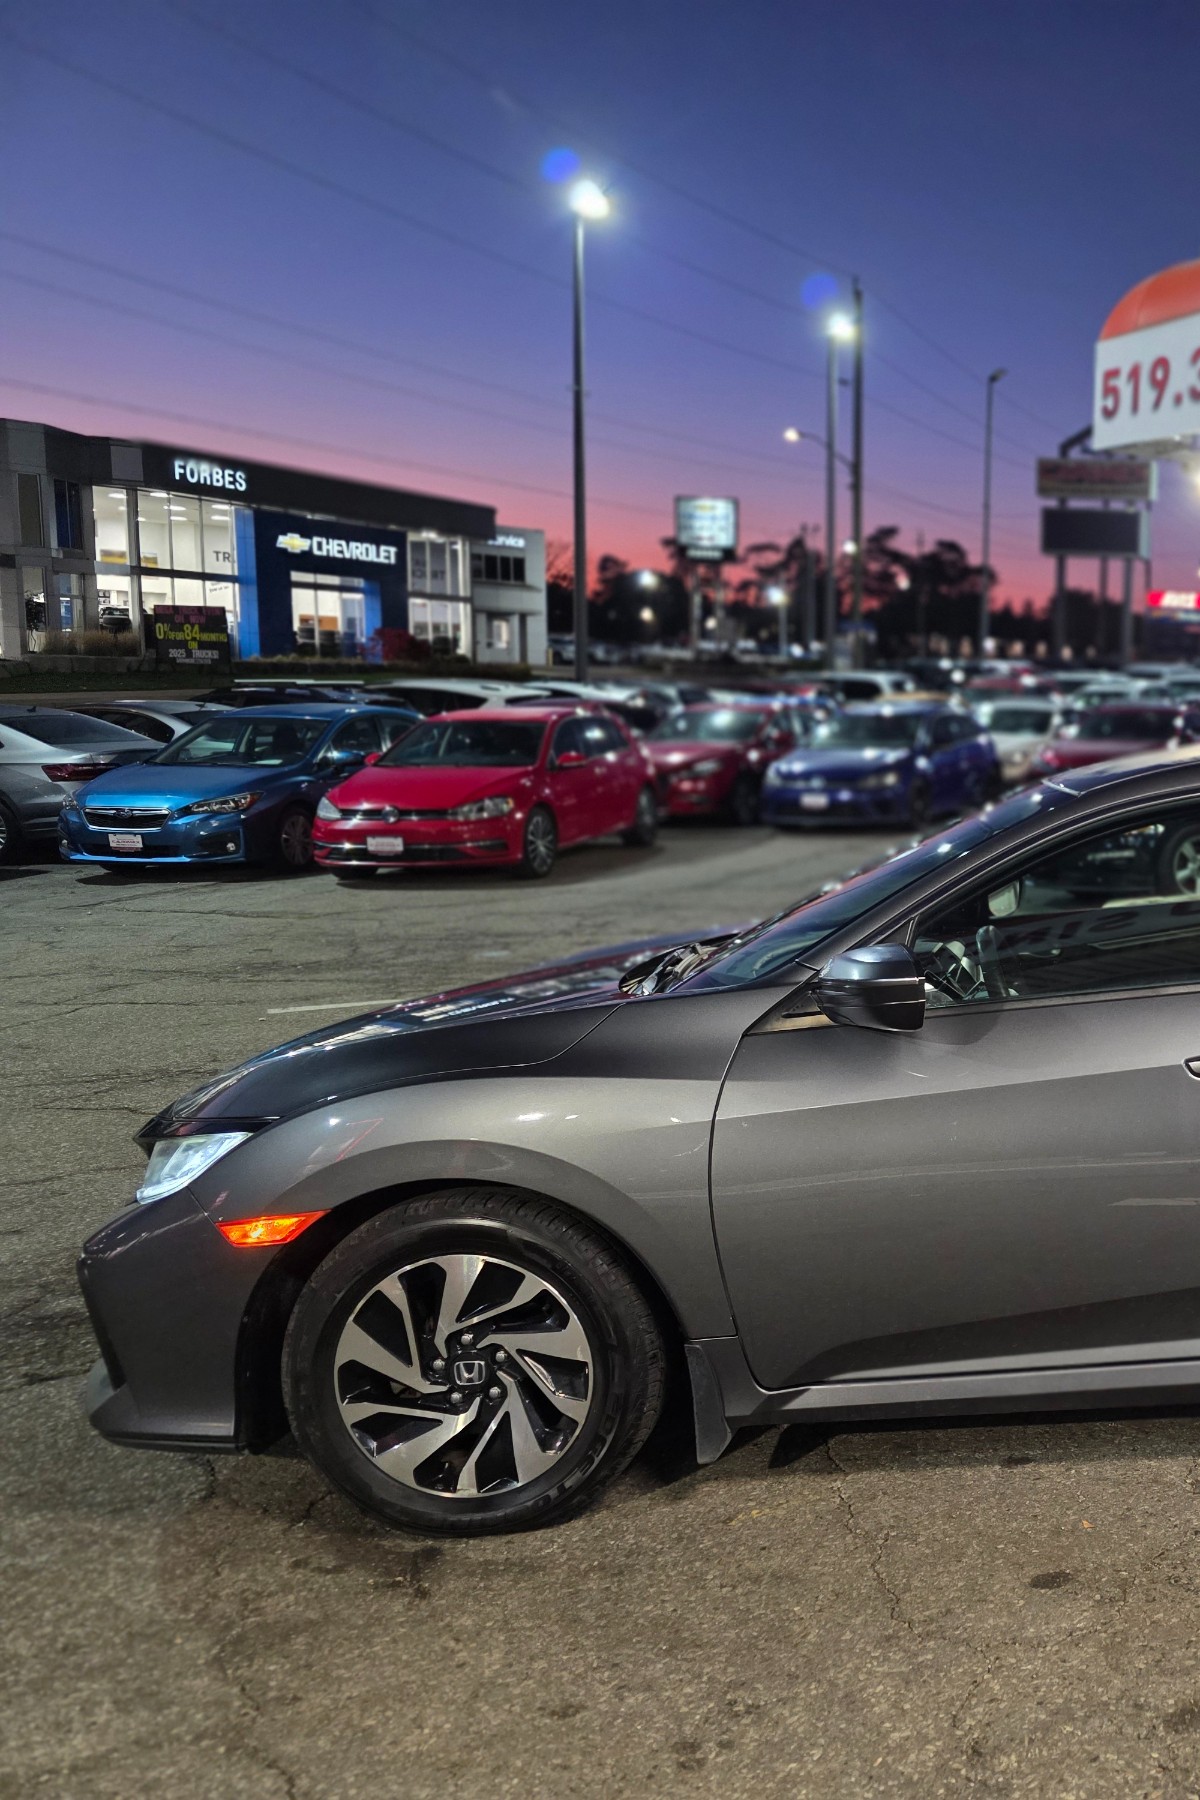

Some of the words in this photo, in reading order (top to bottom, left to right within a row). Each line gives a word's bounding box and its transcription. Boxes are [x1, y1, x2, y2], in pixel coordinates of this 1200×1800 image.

[174, 459, 247, 491] FORBES
[312, 535, 398, 565] CHEVROLET
[183, 623, 200, 640] 84
[200, 632, 227, 642] MONTHS
[168, 648, 186, 658] 2025
[188, 641, 198, 649] ON
